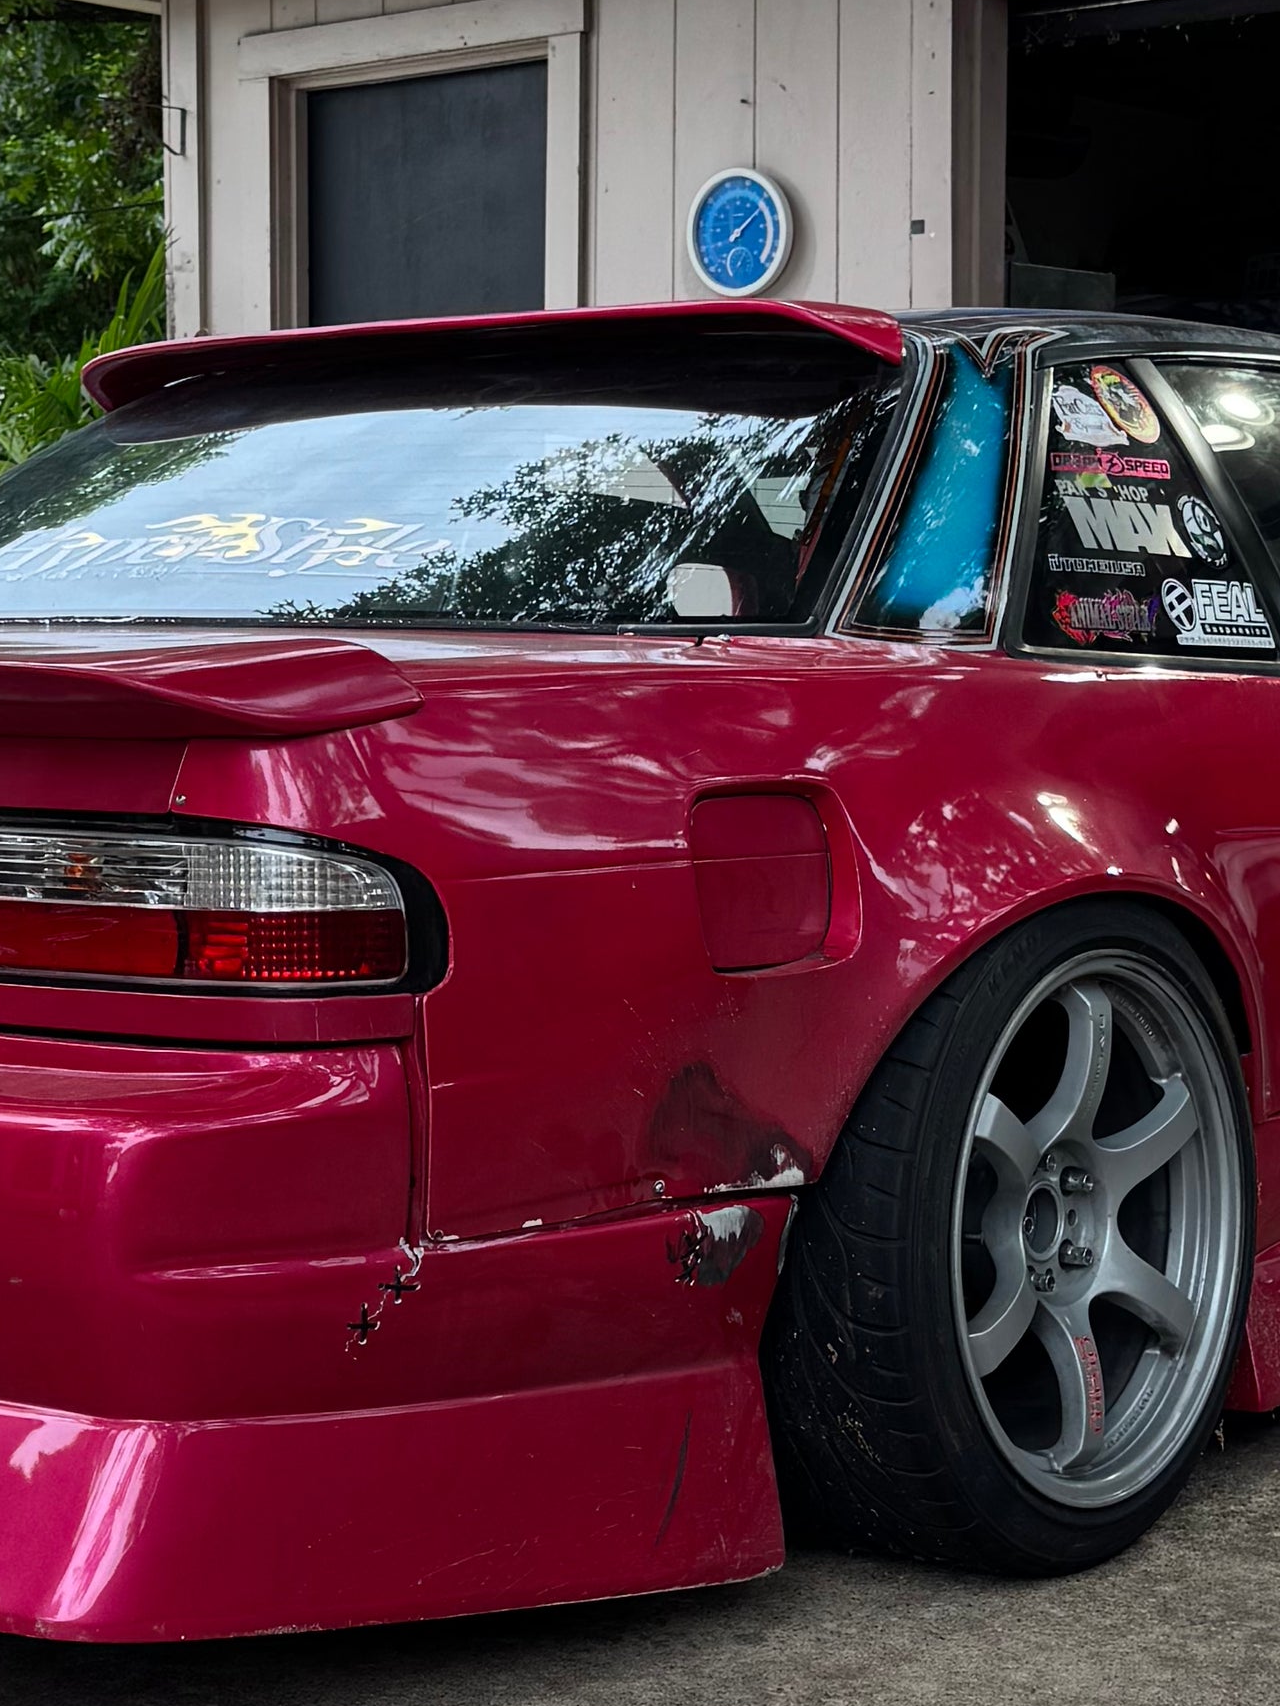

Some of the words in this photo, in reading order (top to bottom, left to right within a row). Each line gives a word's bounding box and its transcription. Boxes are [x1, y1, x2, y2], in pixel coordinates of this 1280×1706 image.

[1124, 459, 1169, 474] SPEED
[1062, 495, 1193, 559] MAX
[1192, 579, 1268, 624] FEAL
